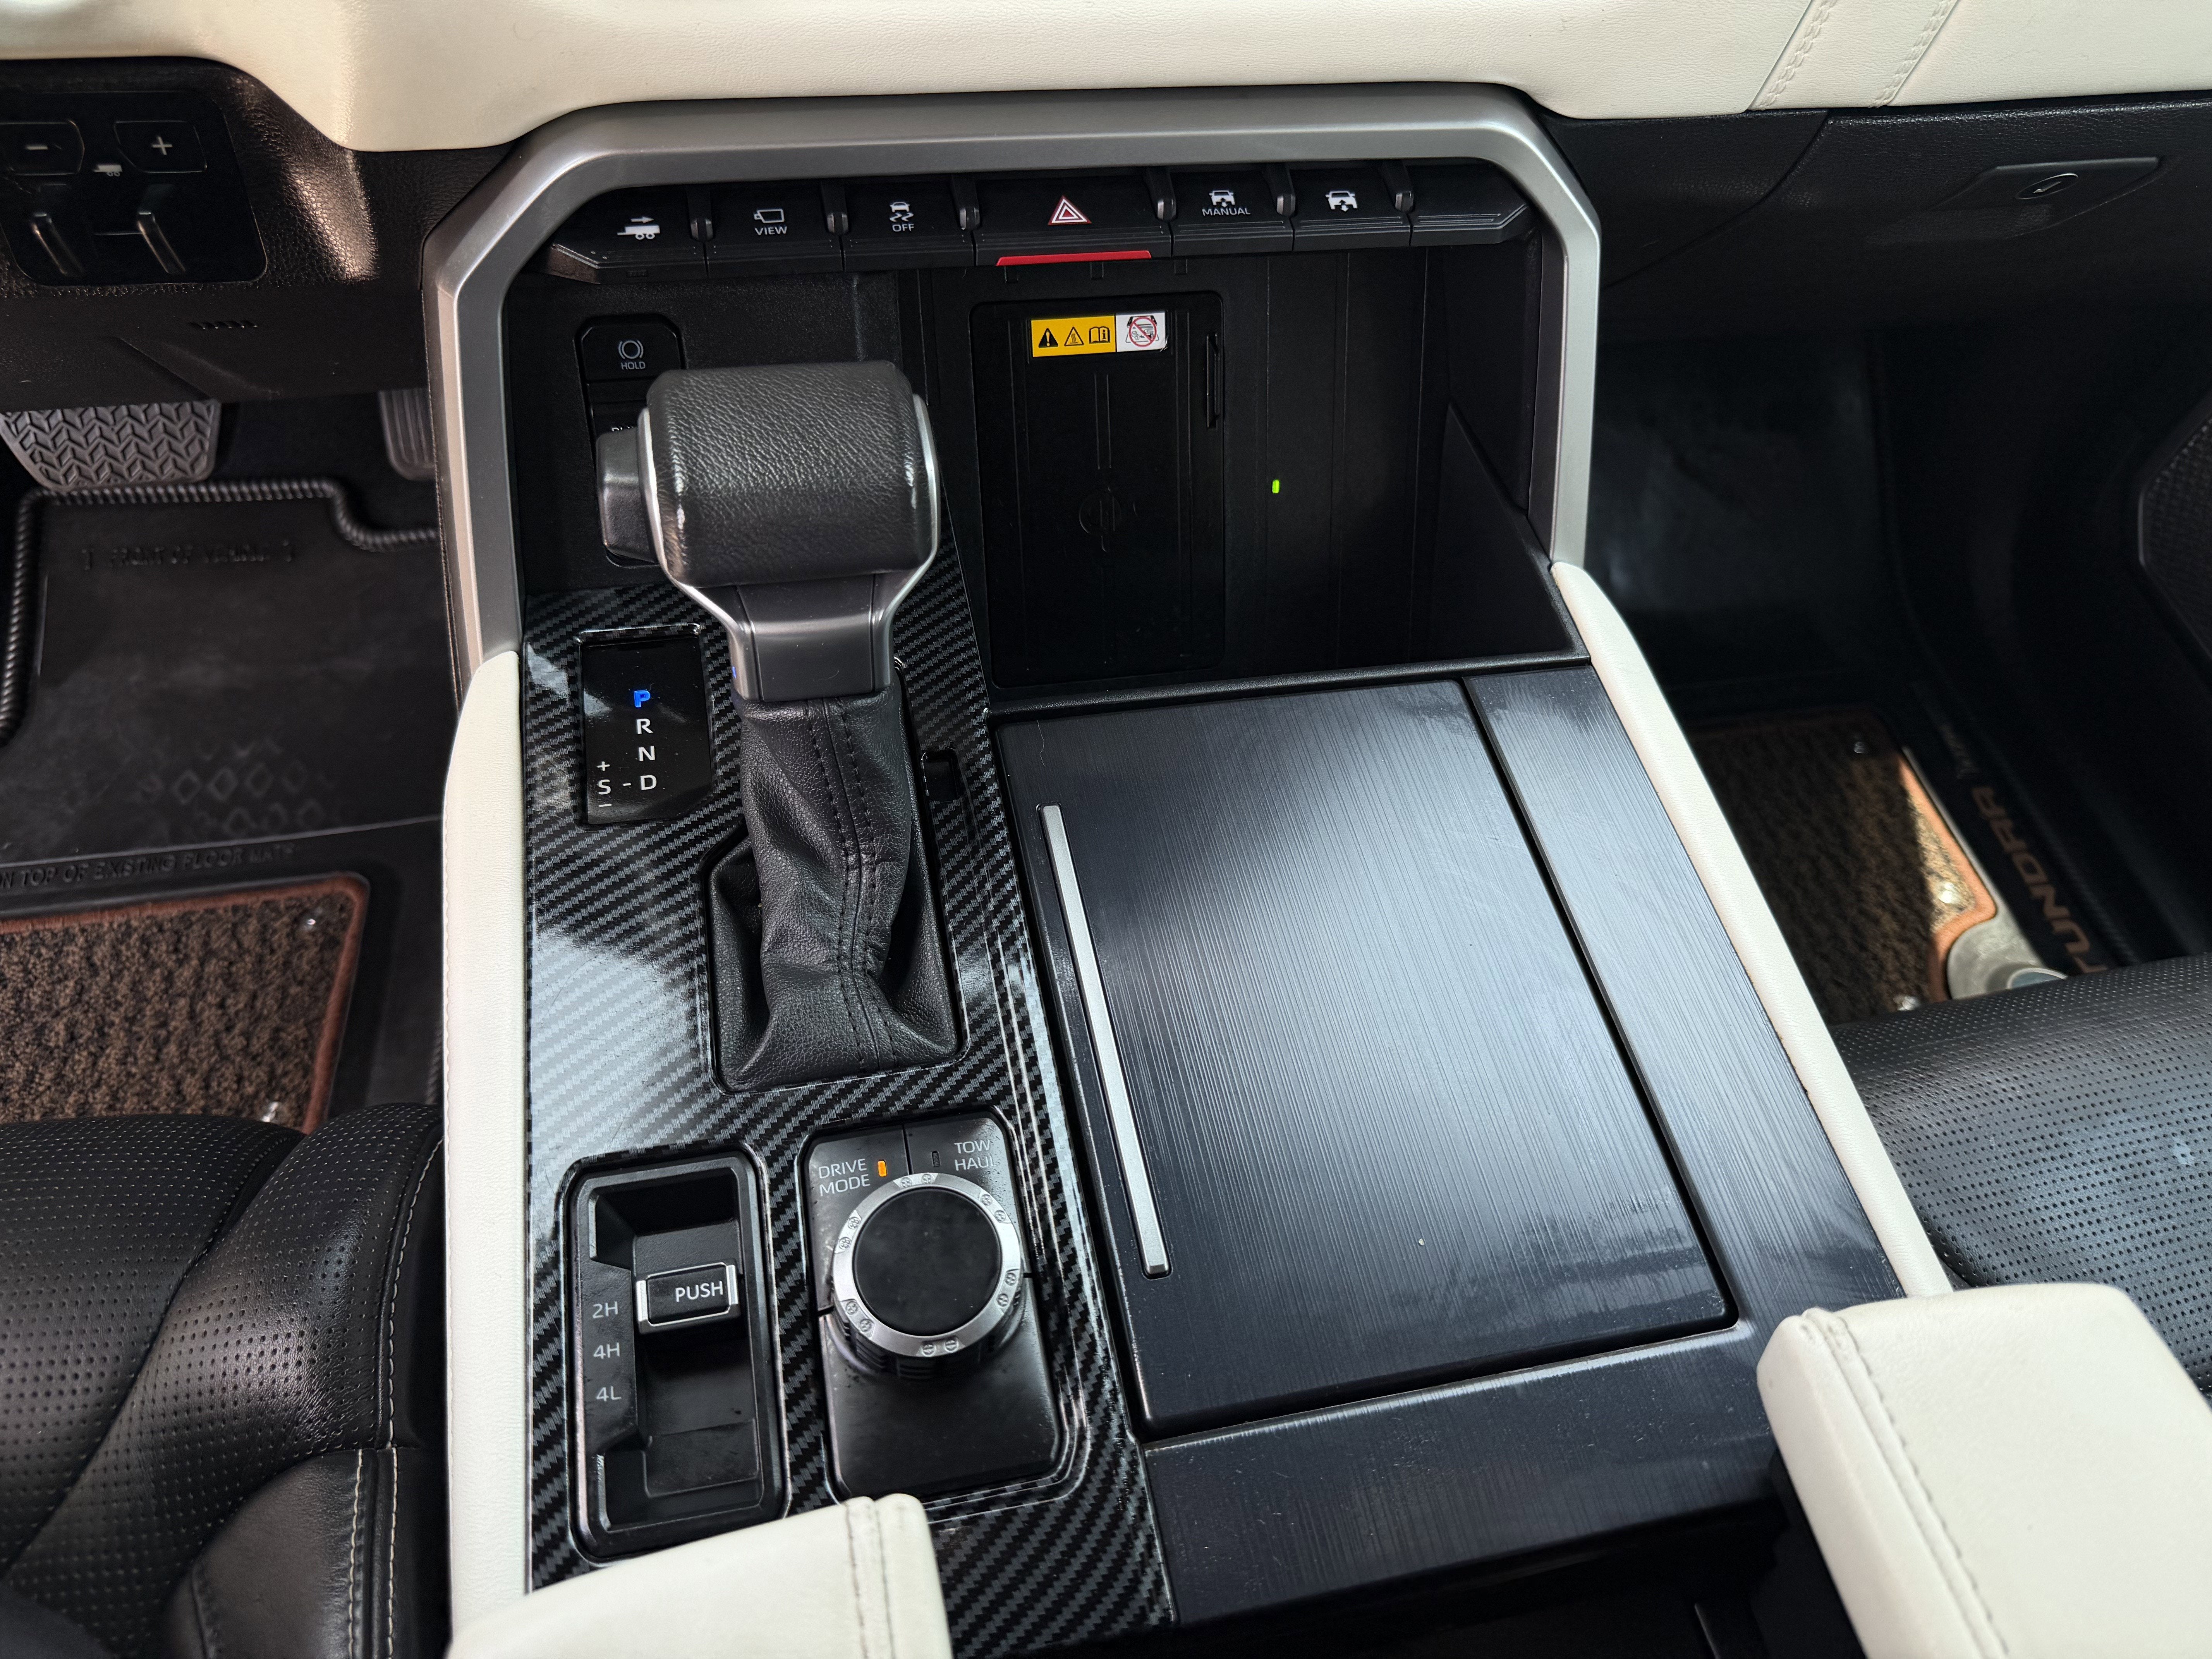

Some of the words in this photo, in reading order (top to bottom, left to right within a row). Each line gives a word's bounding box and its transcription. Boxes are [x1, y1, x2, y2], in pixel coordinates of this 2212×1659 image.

[1202, 207, 1251, 216] MANUAL
[754, 225, 787, 235] VIEW
[892, 223, 914, 232] OFF
[620, 361, 646, 370] HOLD
[633, 689, 651, 708] P
[636, 718, 653, 735] R
[638, 745, 656, 762] N
[598, 779, 611, 795] S
[640, 775, 657, 791] D
[0, 870, 15, 889] N
[20, 867, 58, 886] TOP
[62, 862, 89, 883] OF
[954, 1139, 990, 1154] TOW
[818, 1159, 867, 1179] DRIVE
[954, 1156, 996, 1171] HAUL
[819, 1174, 871, 1197] MODE
[675, 1281, 724, 1302] PUSH
[592, 1302, 618, 1319] 2H
[593, 1342, 620, 1359] 4H
[596, 1386, 622, 1401] 4L
